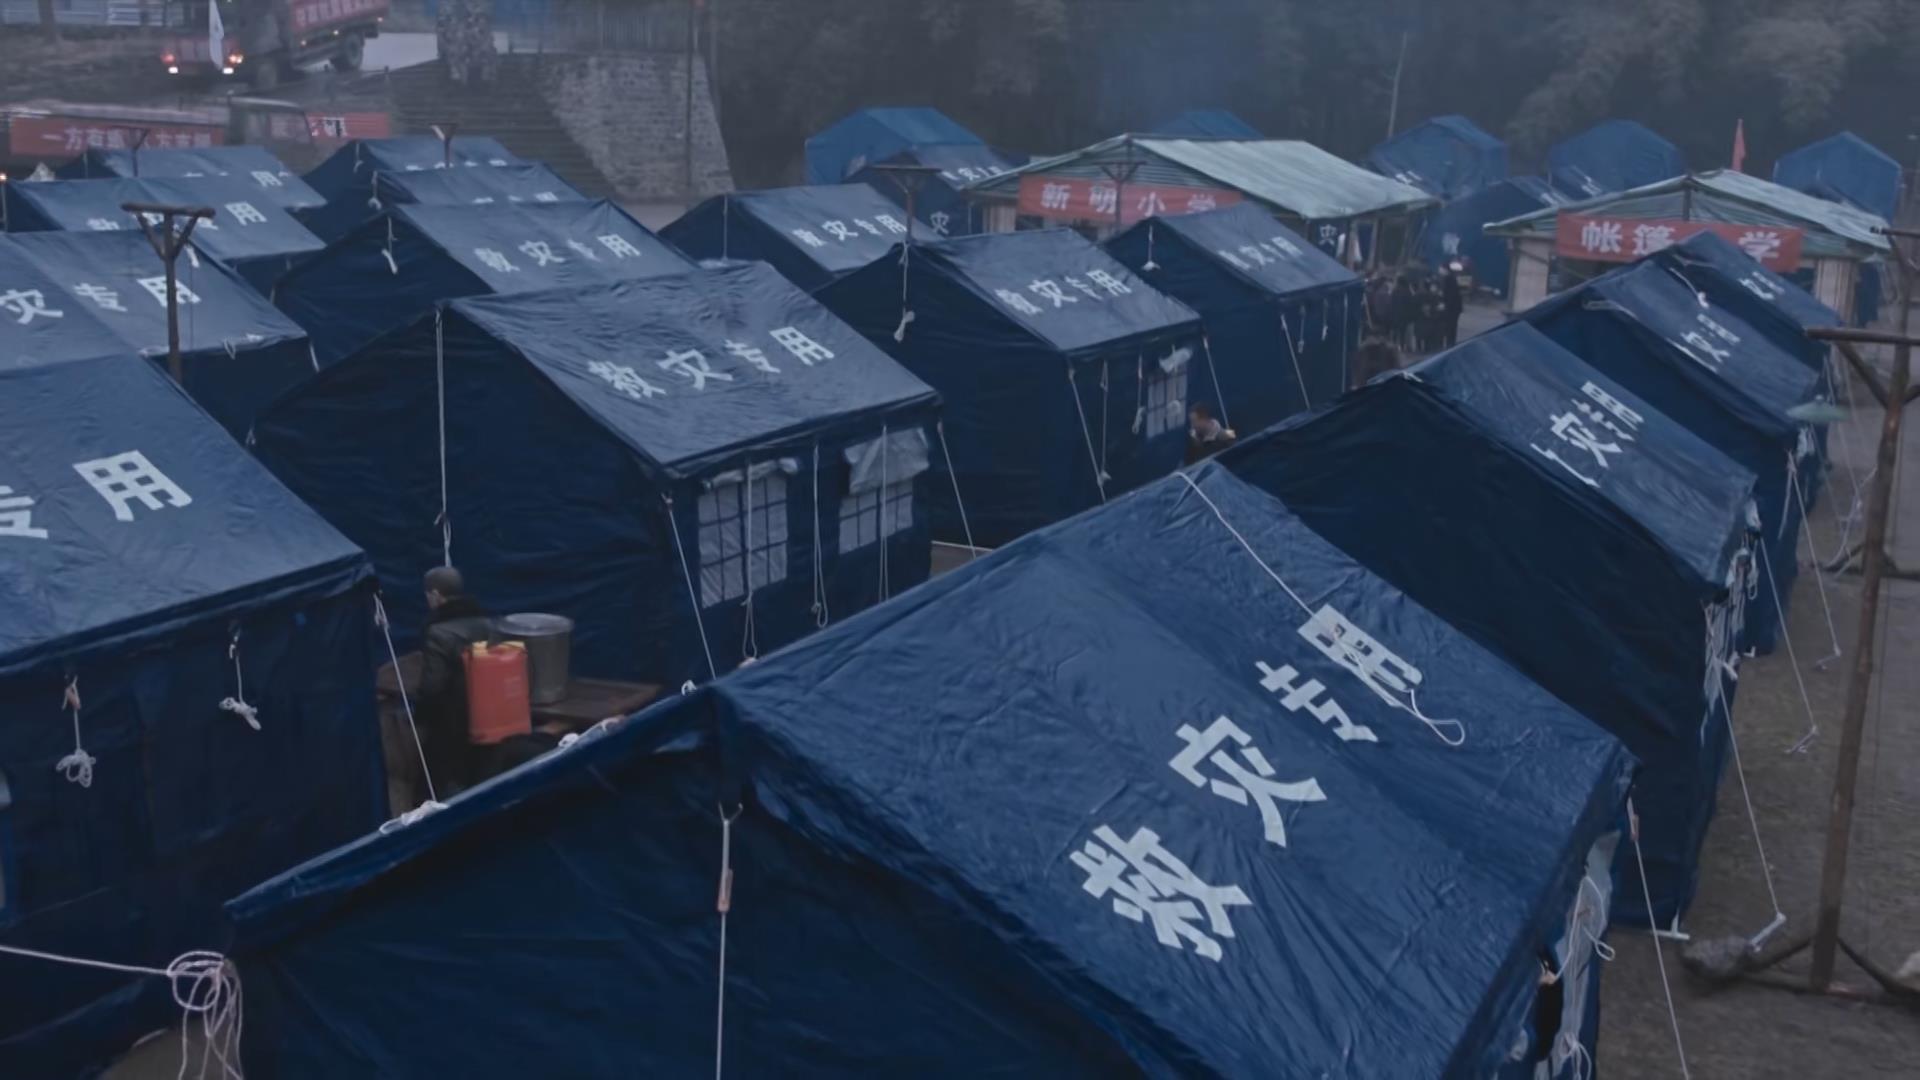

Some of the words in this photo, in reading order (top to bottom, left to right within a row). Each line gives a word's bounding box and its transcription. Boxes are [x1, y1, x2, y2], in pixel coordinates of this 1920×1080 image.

[1581, 220, 1782, 263] 帐篷学
[588, 325, 835, 400] 救灾专用
